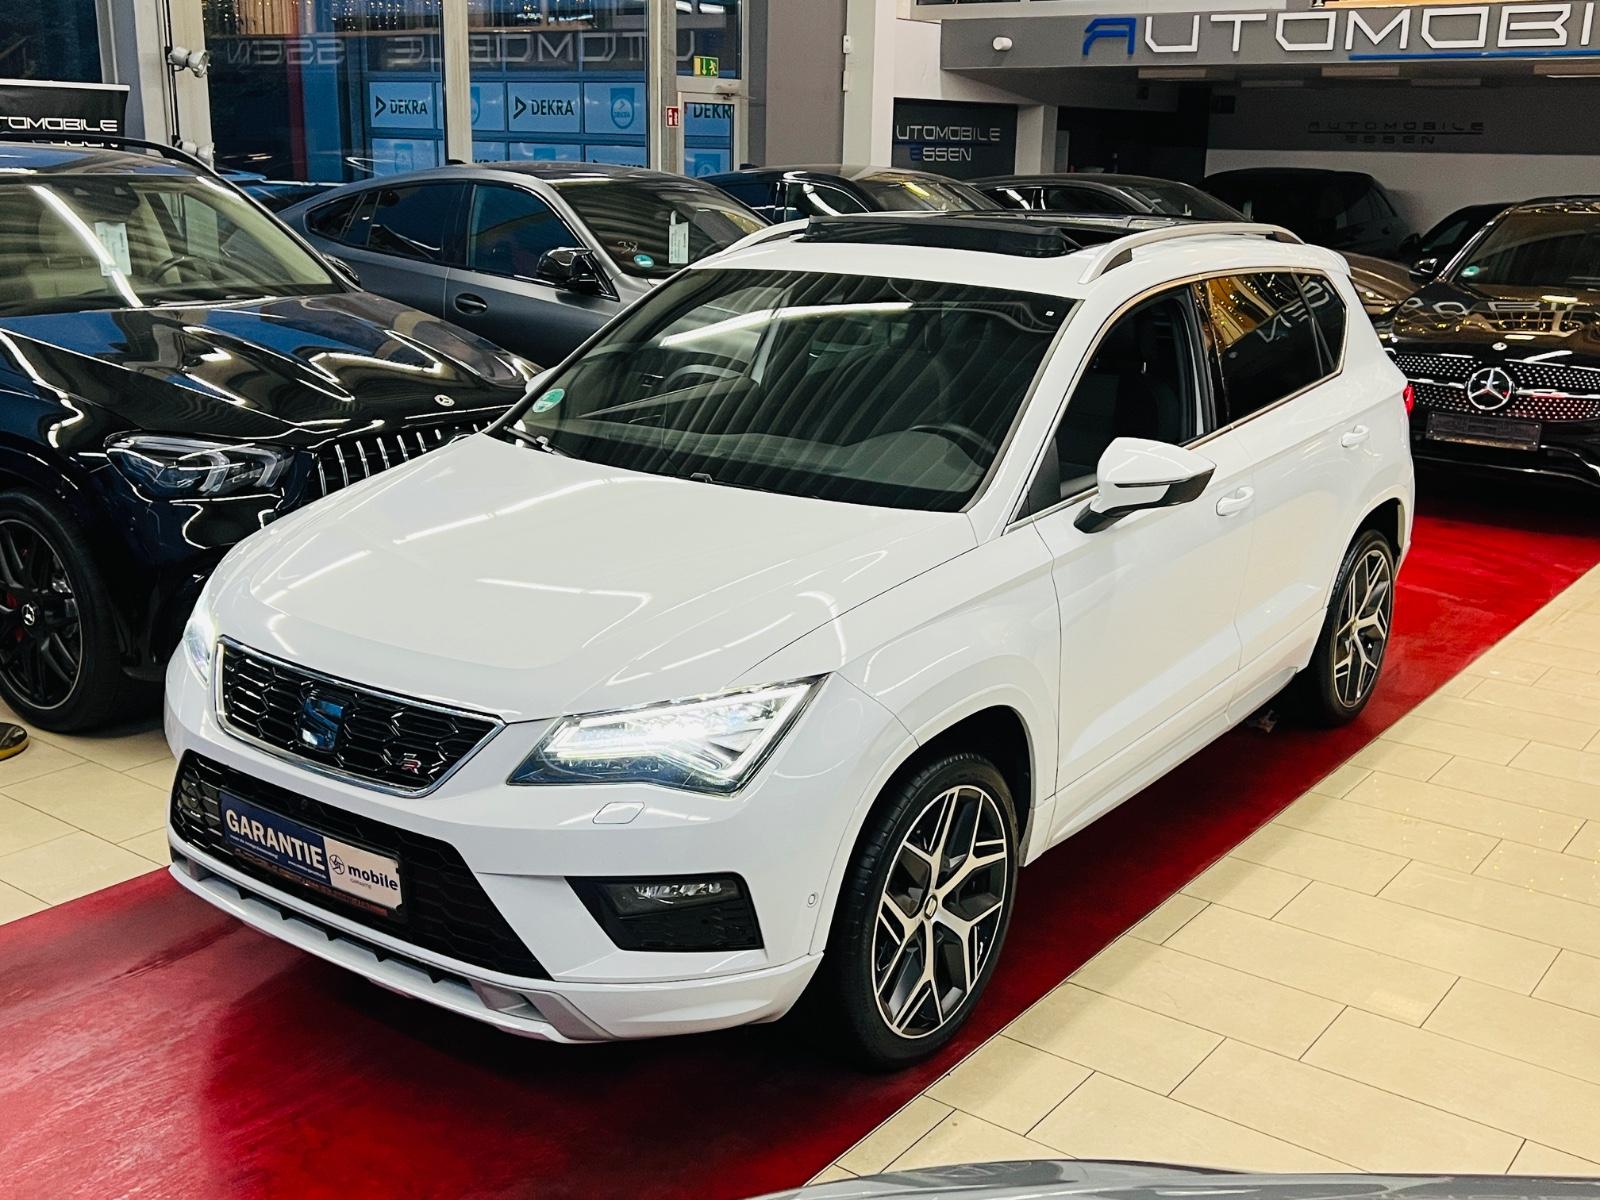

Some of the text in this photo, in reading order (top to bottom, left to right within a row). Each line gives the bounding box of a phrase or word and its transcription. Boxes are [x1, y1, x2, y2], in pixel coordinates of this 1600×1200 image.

[1082, 2, 1590, 56] AUTOMOBI
[390, 98, 428, 115] DEKRA
[531, 98, 575, 117] DEKRA
[1307, 121, 1485, 131] AUTOMOBILE
[909, 145, 972, 161] ESSEN
[225, 808, 326, 871] GARANTIE
[347, 865, 399, 891] mobile
